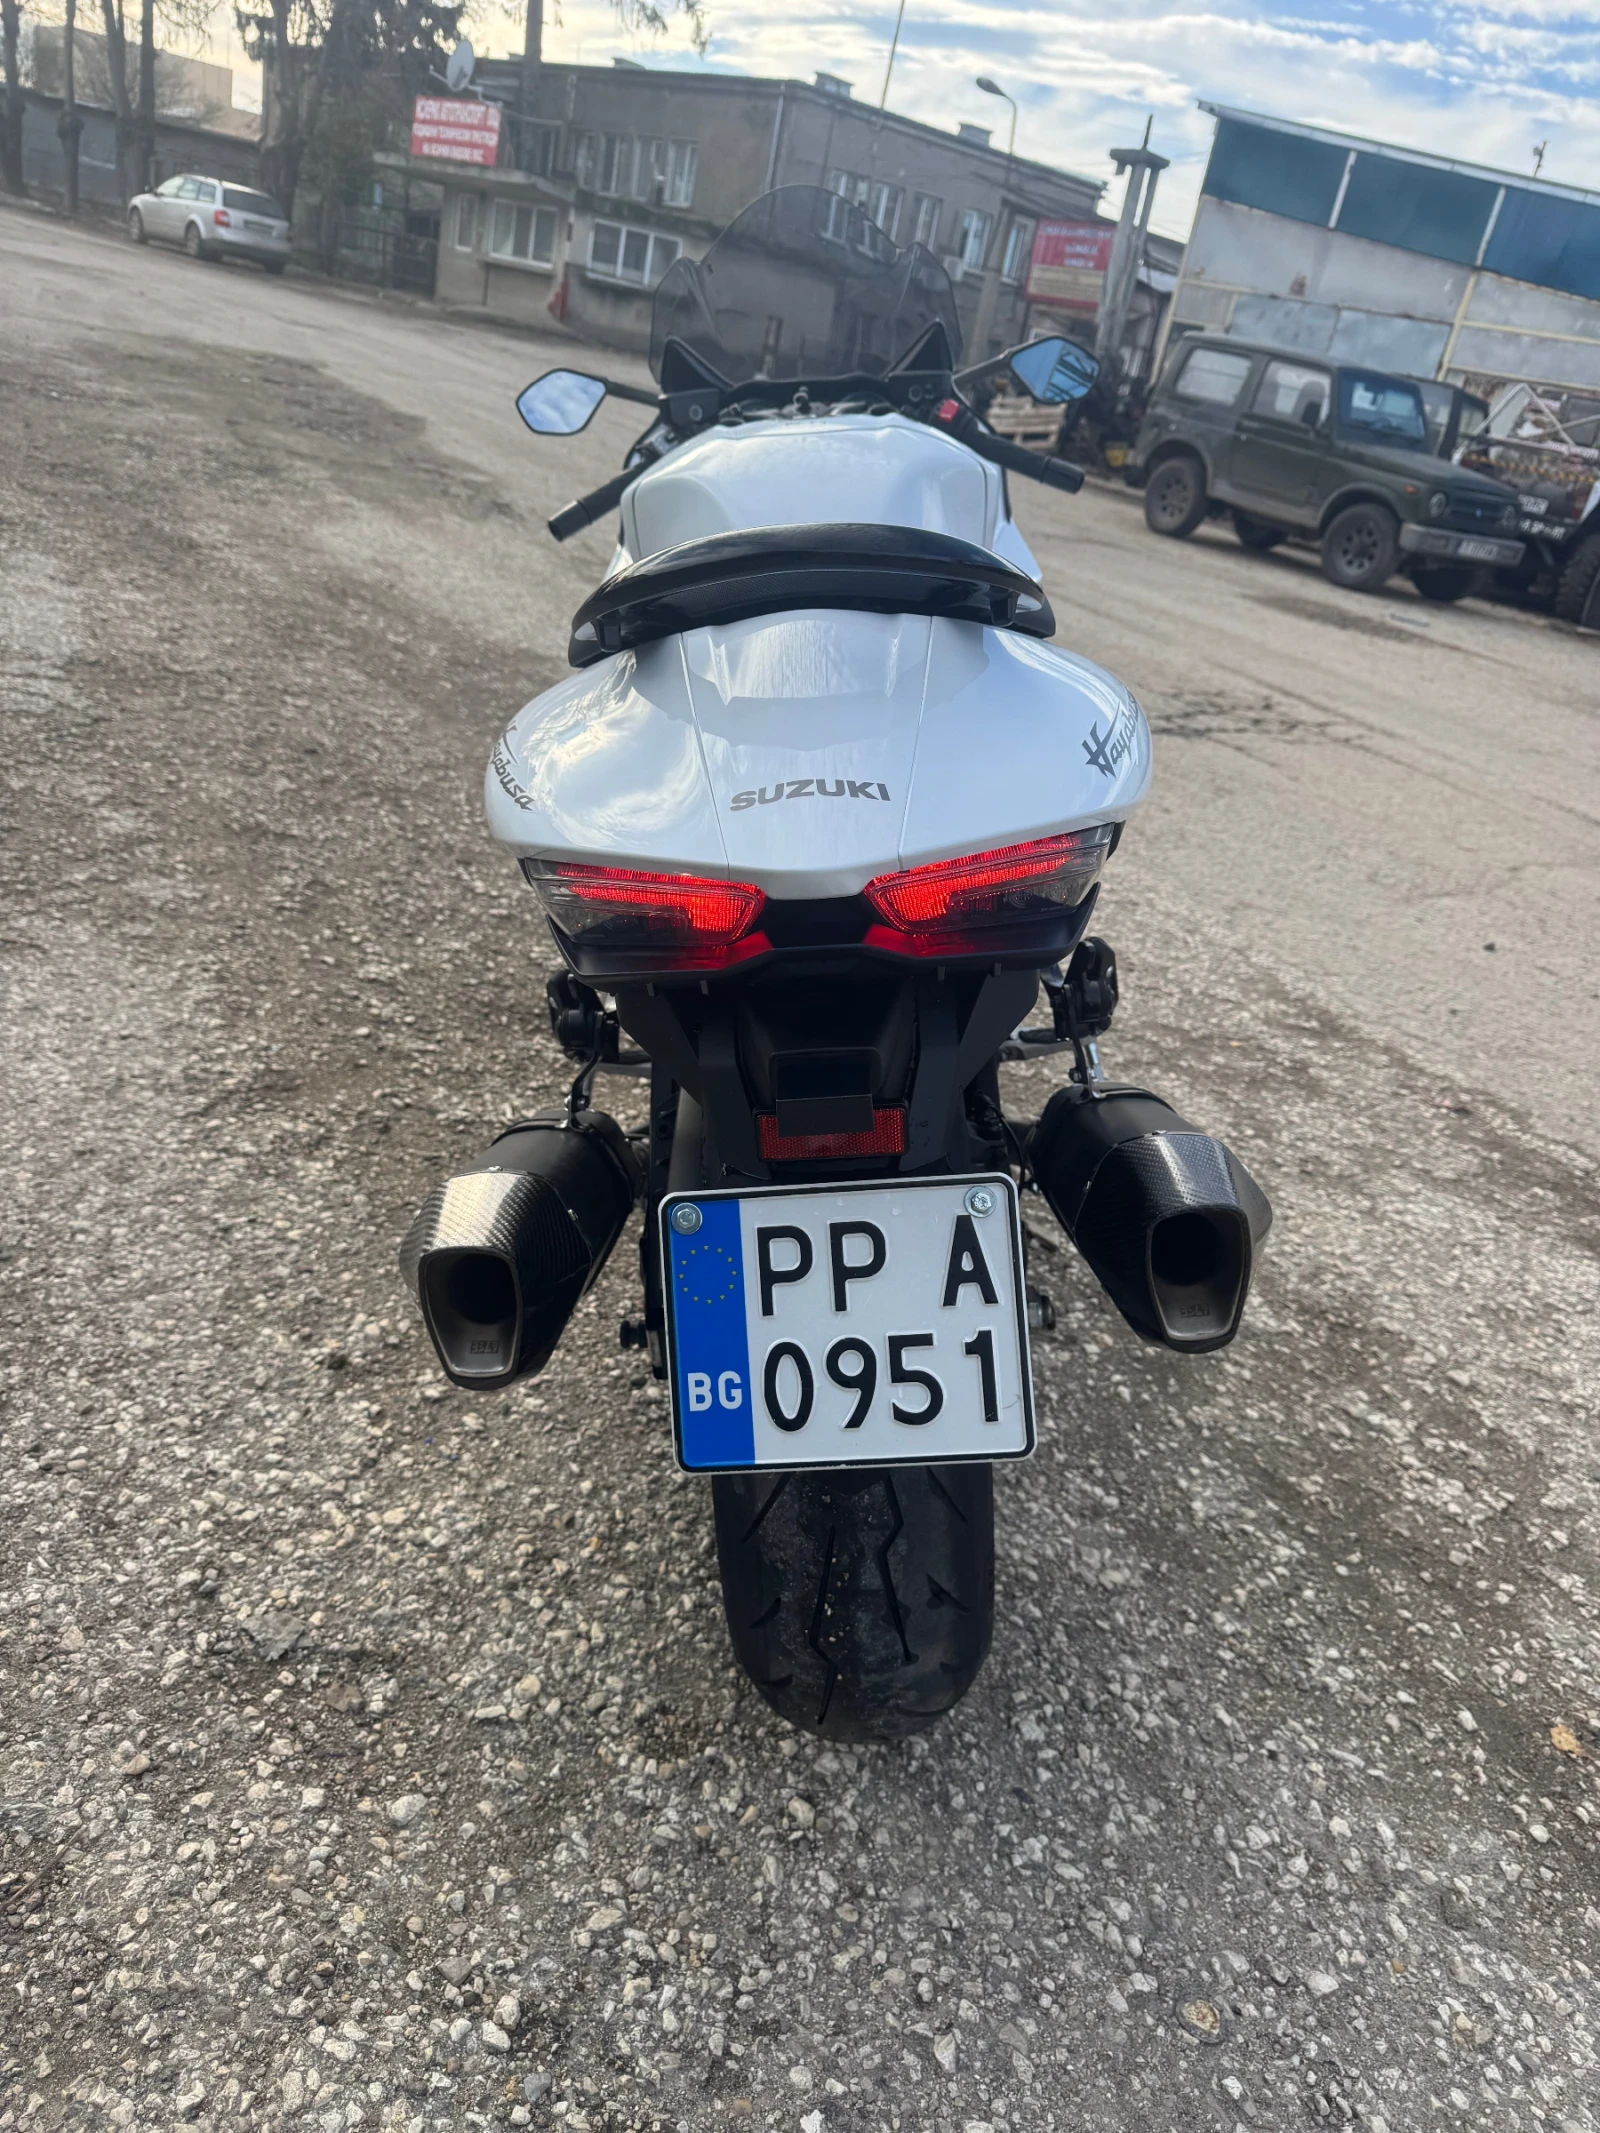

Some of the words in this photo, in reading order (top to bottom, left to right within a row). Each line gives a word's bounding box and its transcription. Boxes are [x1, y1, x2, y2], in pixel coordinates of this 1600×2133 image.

[729, 778, 891, 812] SUZUKI
[756, 1219, 887, 1317] PP
[942, 1214, 999, 1307] A
[687, 1370, 743, 1413] BG
[763, 1329, 999, 1432] 0951
